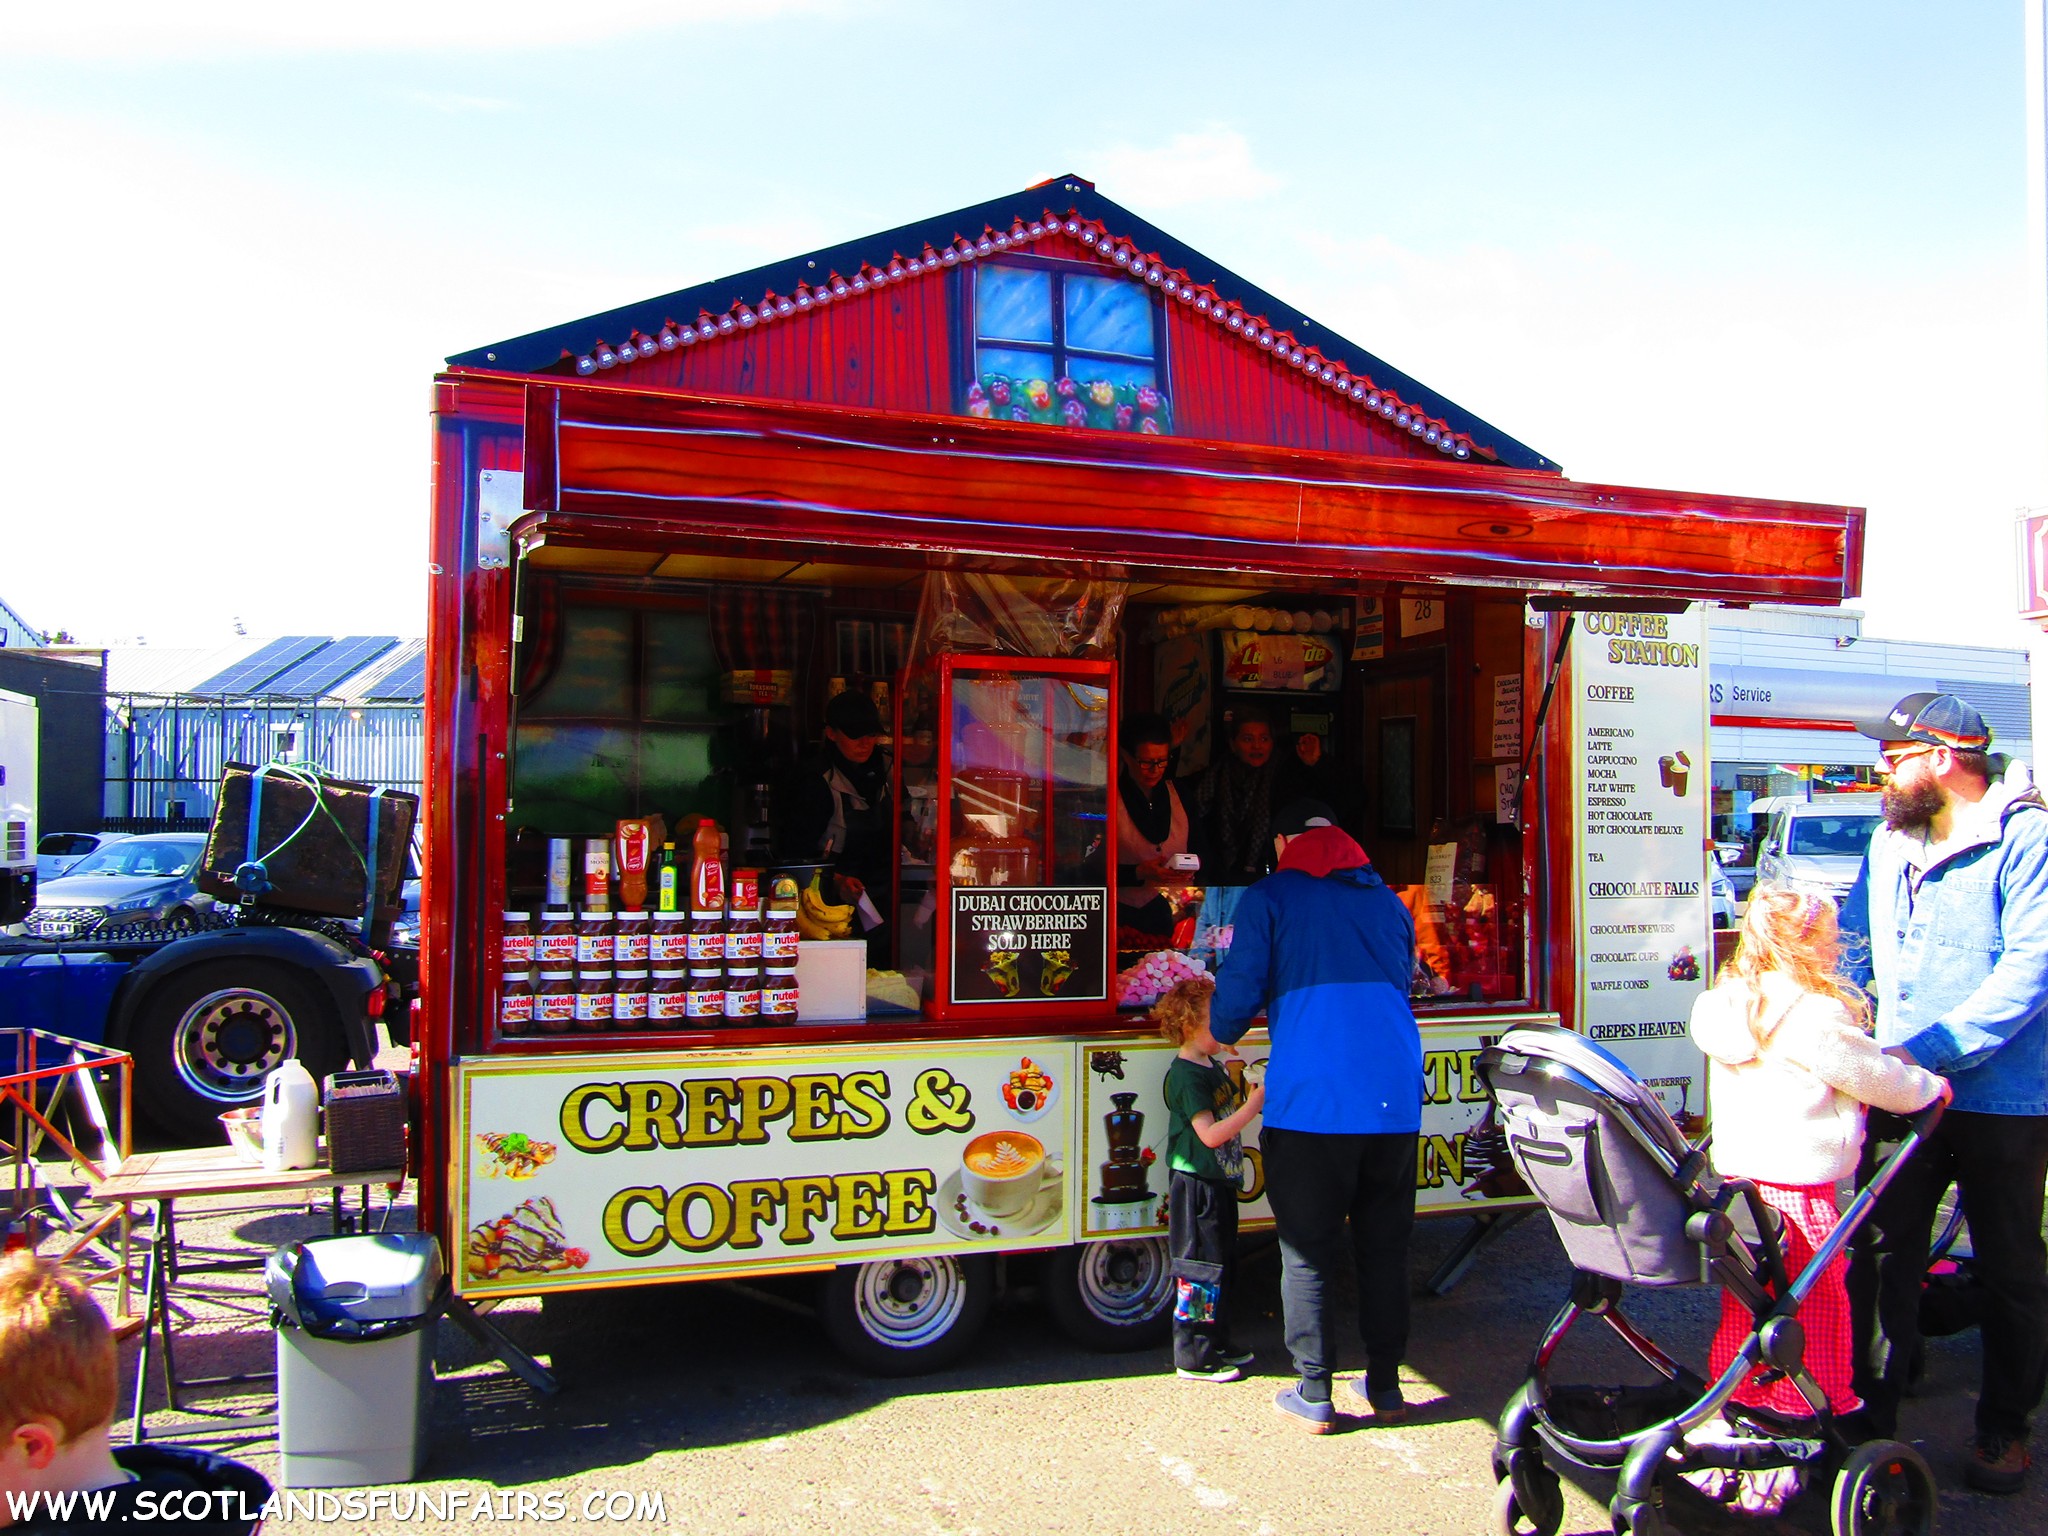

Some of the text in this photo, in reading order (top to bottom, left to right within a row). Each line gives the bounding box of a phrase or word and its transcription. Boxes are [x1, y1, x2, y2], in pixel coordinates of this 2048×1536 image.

[1414, 598, 1431, 621] 28
[1583, 611, 1668, 638] COFFEE
[1608, 638, 1698, 668] STATION
[1587, 684, 1634, 700] COFFEE
[1733, 686, 1772, 702] Service
[1587, 727, 1634, 738] AMERICANO
[1587, 742, 1612, 751] LATTE
[1587, 755, 1637, 765] CAPPUCCINO
[1587, 769, 1617, 778] MOCHA
[1588, 783, 1636, 793] FLAT WHITE
[1588, 797, 1626, 806] ESPRESSO
[1588, 811, 1652, 820] HOT CHOCOLATE
[1588, 825, 1684, 835] HOT CHOCOLATE DELUXE
[1588, 852, 1604, 862] TEA
[1589, 882, 1698, 896] CHOCOLATE FALLS
[958, 895, 1100, 912] DUBAI CHOCOLATE
[56, 924, 72, 932] AFY
[971, 914, 1088, 931] STRAWBERRIES
[1590, 924, 1675, 934] CHOCOLATE SKEWERS
[988, 934, 1072, 950] SOLD HERE
[1590, 952, 1659, 962] CHOCOLATE CUPS
[1591, 980, 1649, 990] WAFFLE CONES
[1590, 1021, 1686, 1039] CREPES HEAVEN
[1643, 1076, 1692, 1088] RAWBERRIES
[559, 1068, 976, 1154] CREPES &
[602, 1168, 938, 1258] COFFEE
